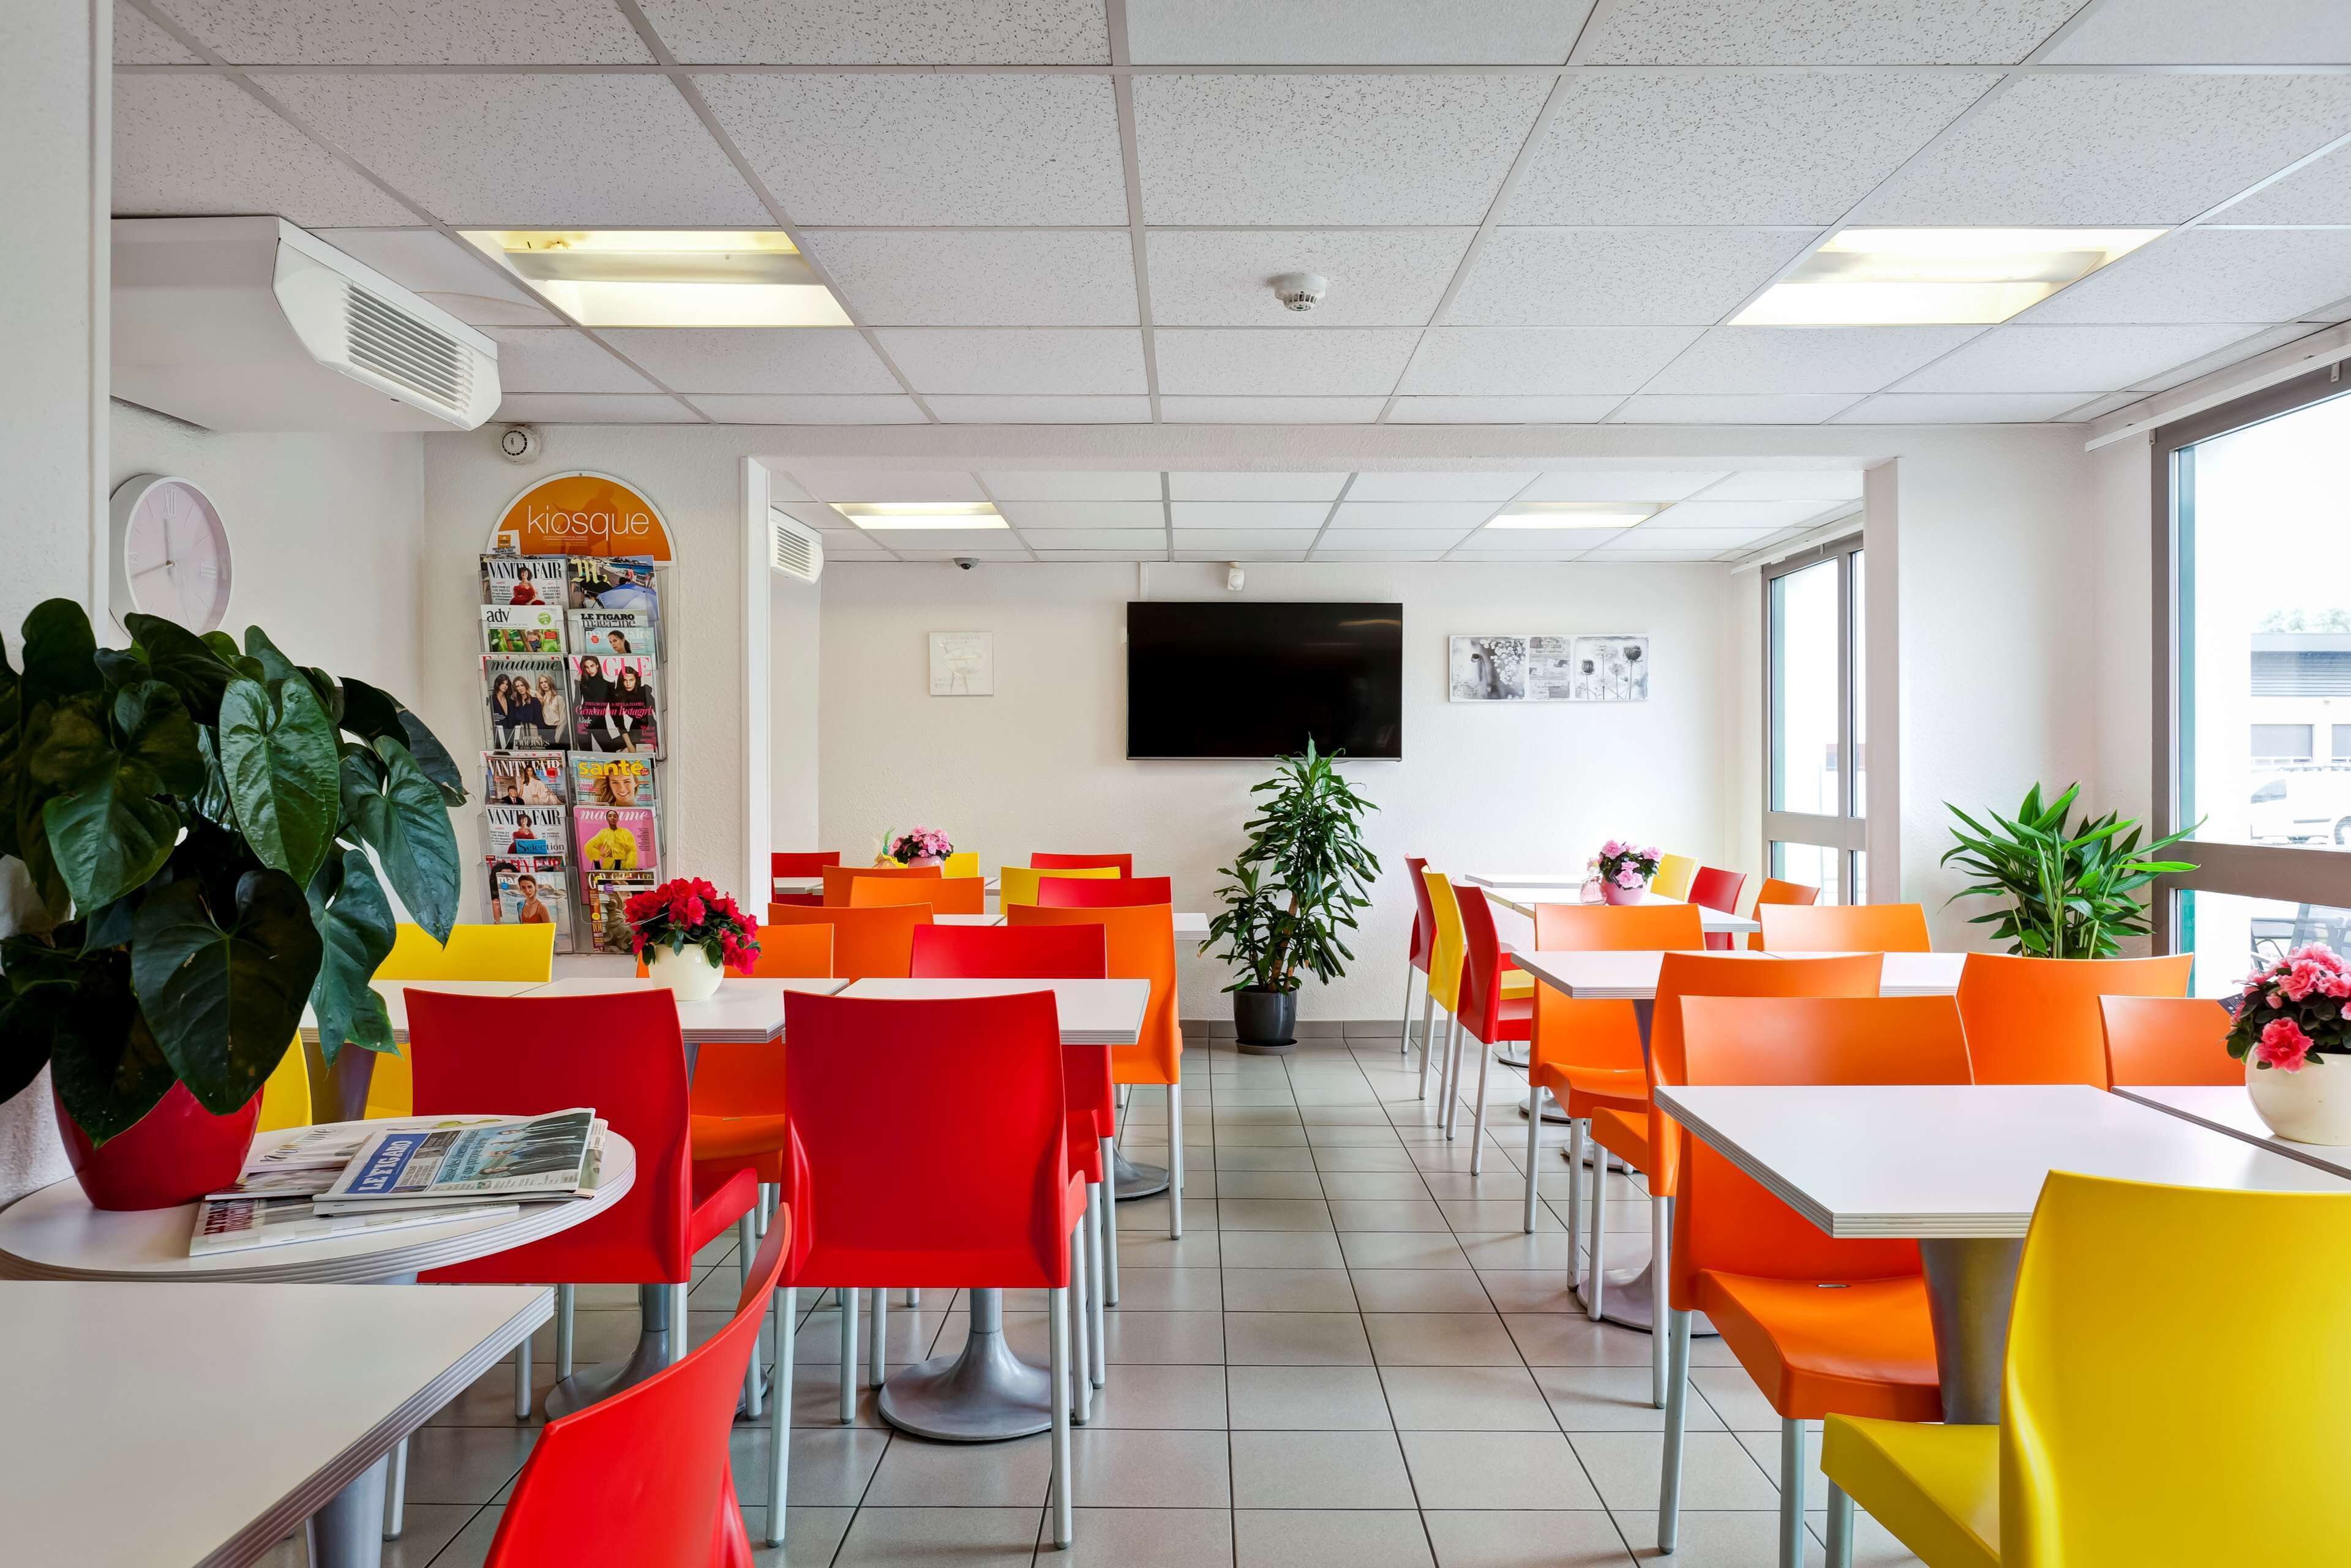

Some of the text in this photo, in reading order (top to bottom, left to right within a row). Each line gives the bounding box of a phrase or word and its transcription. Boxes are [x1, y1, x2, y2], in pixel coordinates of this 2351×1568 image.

[528, 505, 649, 541] kiosque
[489, 562, 562, 579] VANITY FAIR
[490, 659, 558, 671] madame
[488, 760, 561, 776] VANITY FAIR
[577, 760, 645, 776] santé
[487, 809, 561, 825] VANITY FAIR
[580, 809, 648, 820] maame
[358, 1141, 413, 1191] LE FIGARO
[204, 1200, 231, 1234] LE FIGARO
